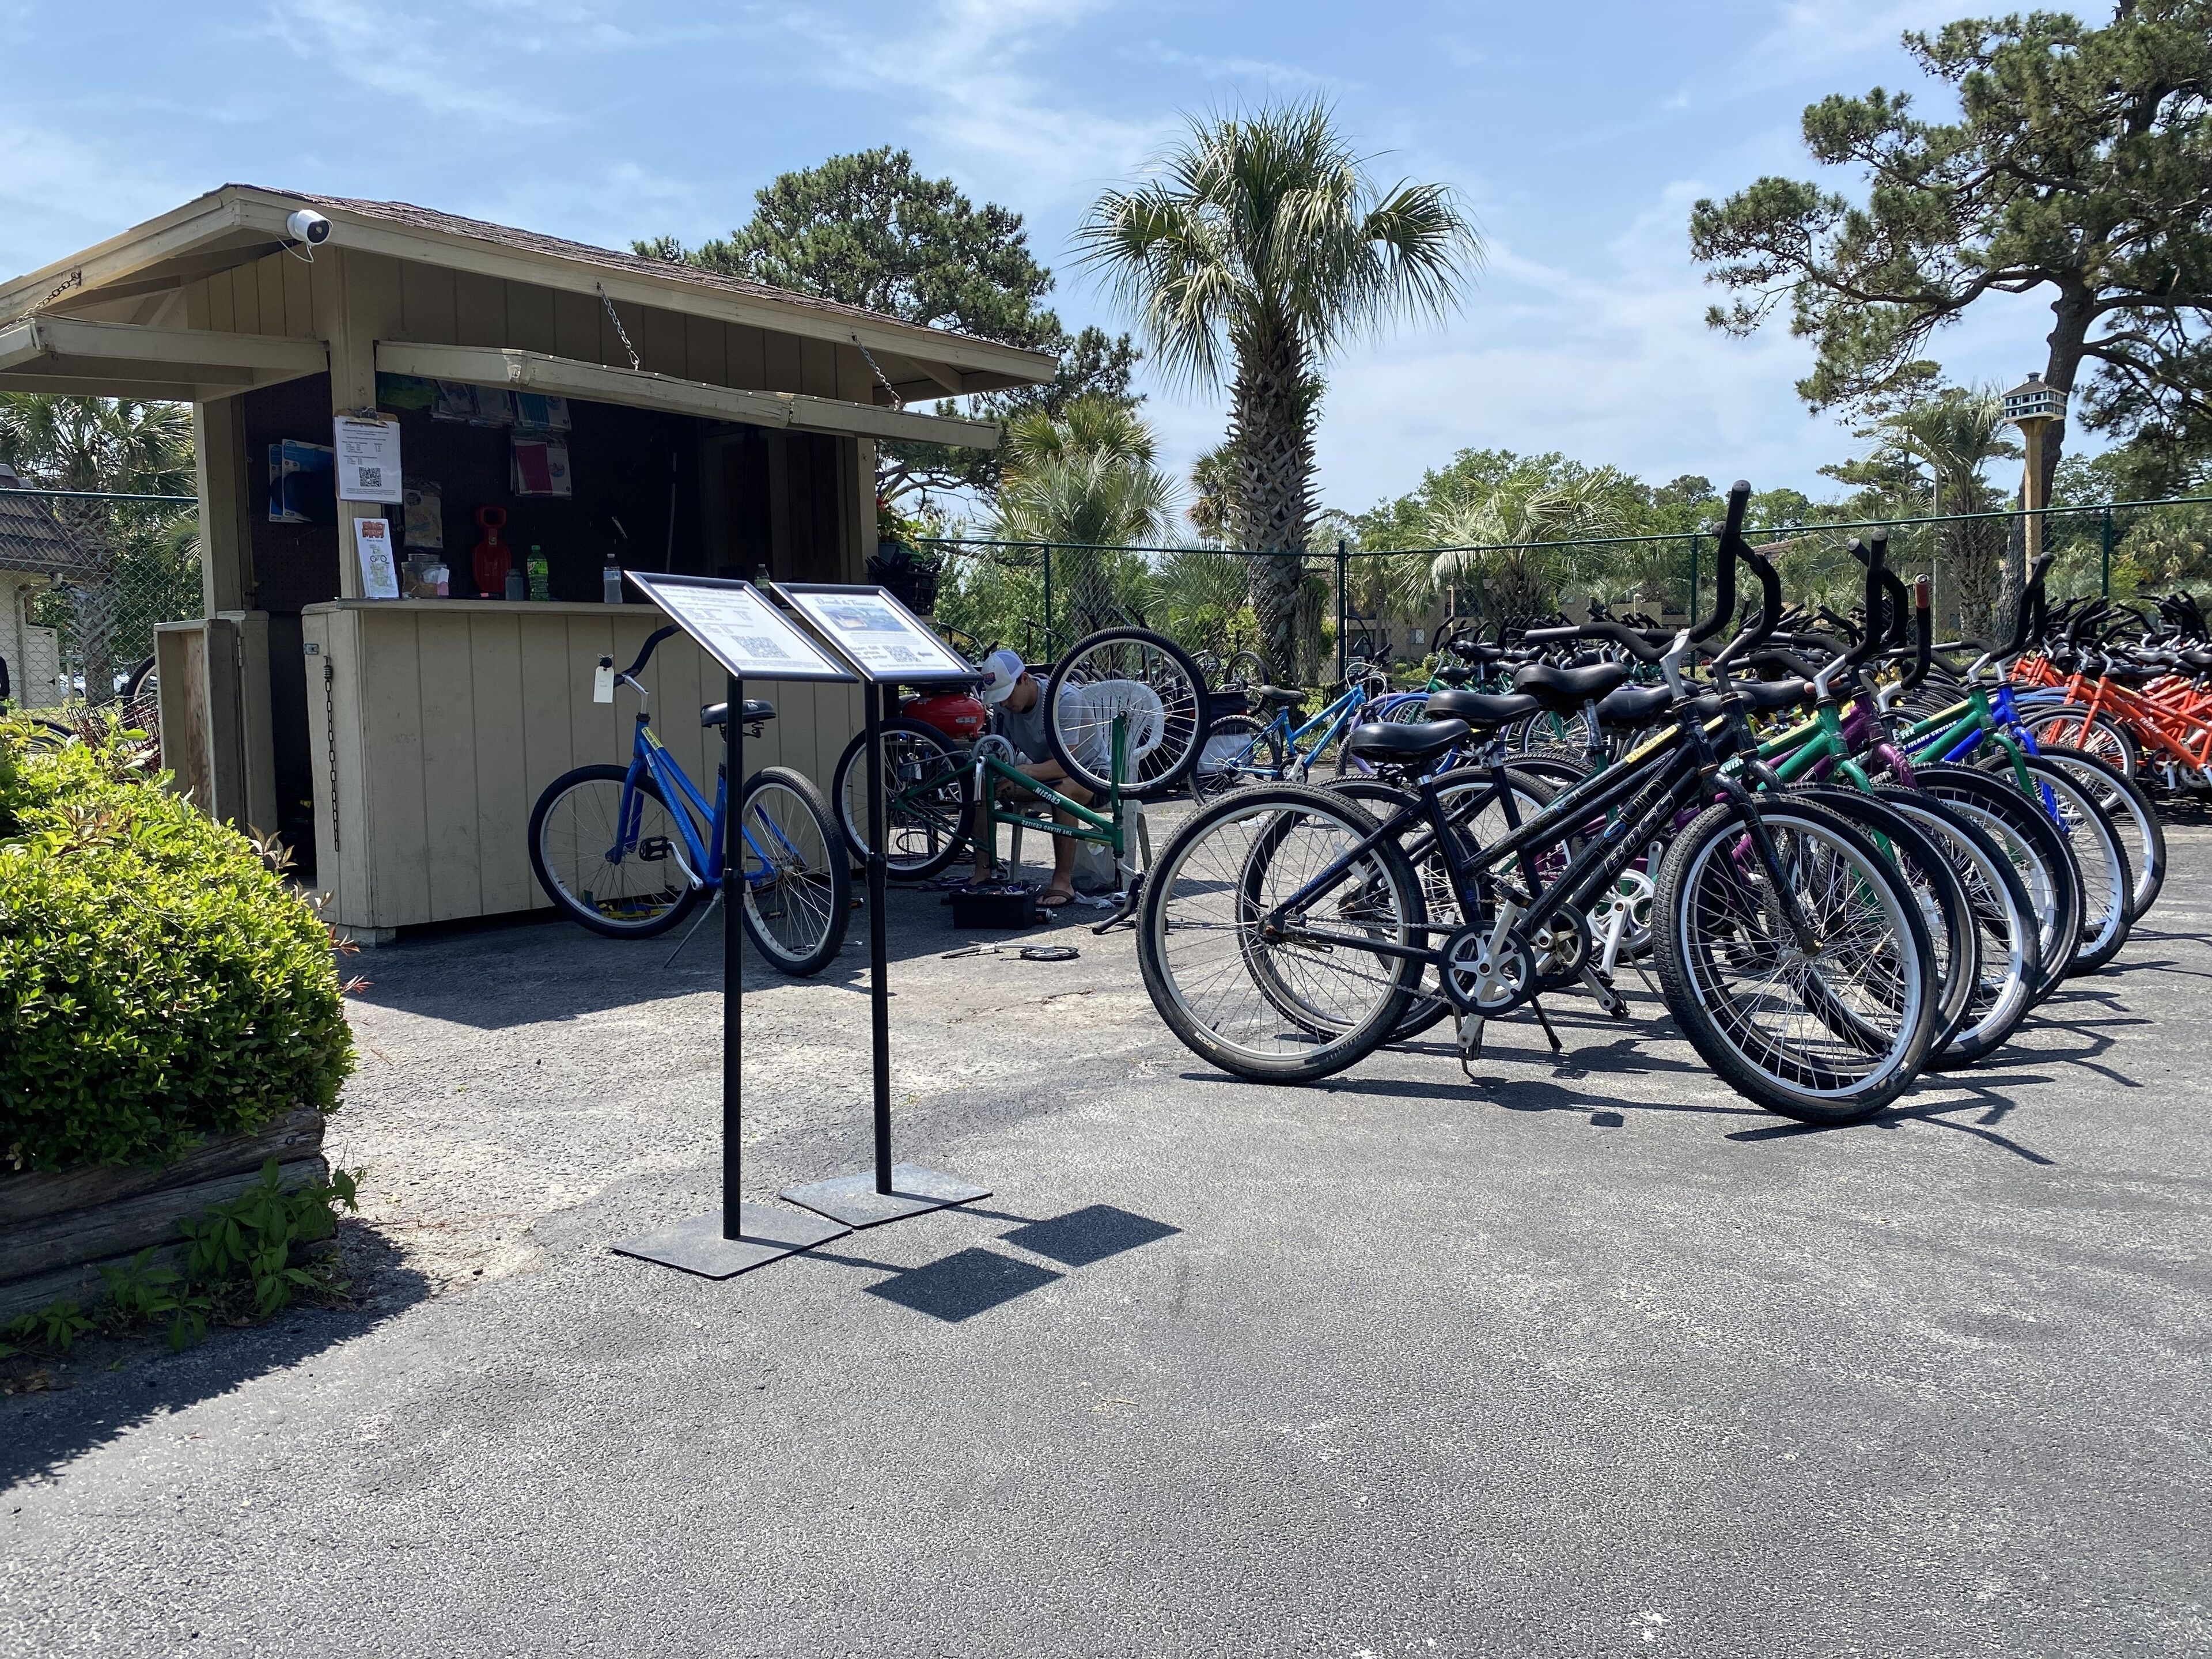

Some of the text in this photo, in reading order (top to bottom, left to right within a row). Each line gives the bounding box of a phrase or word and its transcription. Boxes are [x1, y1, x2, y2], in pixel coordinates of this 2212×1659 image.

[1908, 732, 1930, 748] ISLAND
[1021, 819, 1043, 828] CRUISER
[1043, 825, 1062, 834] ISLAND
[1604, 790, 1675, 876] BOSS
